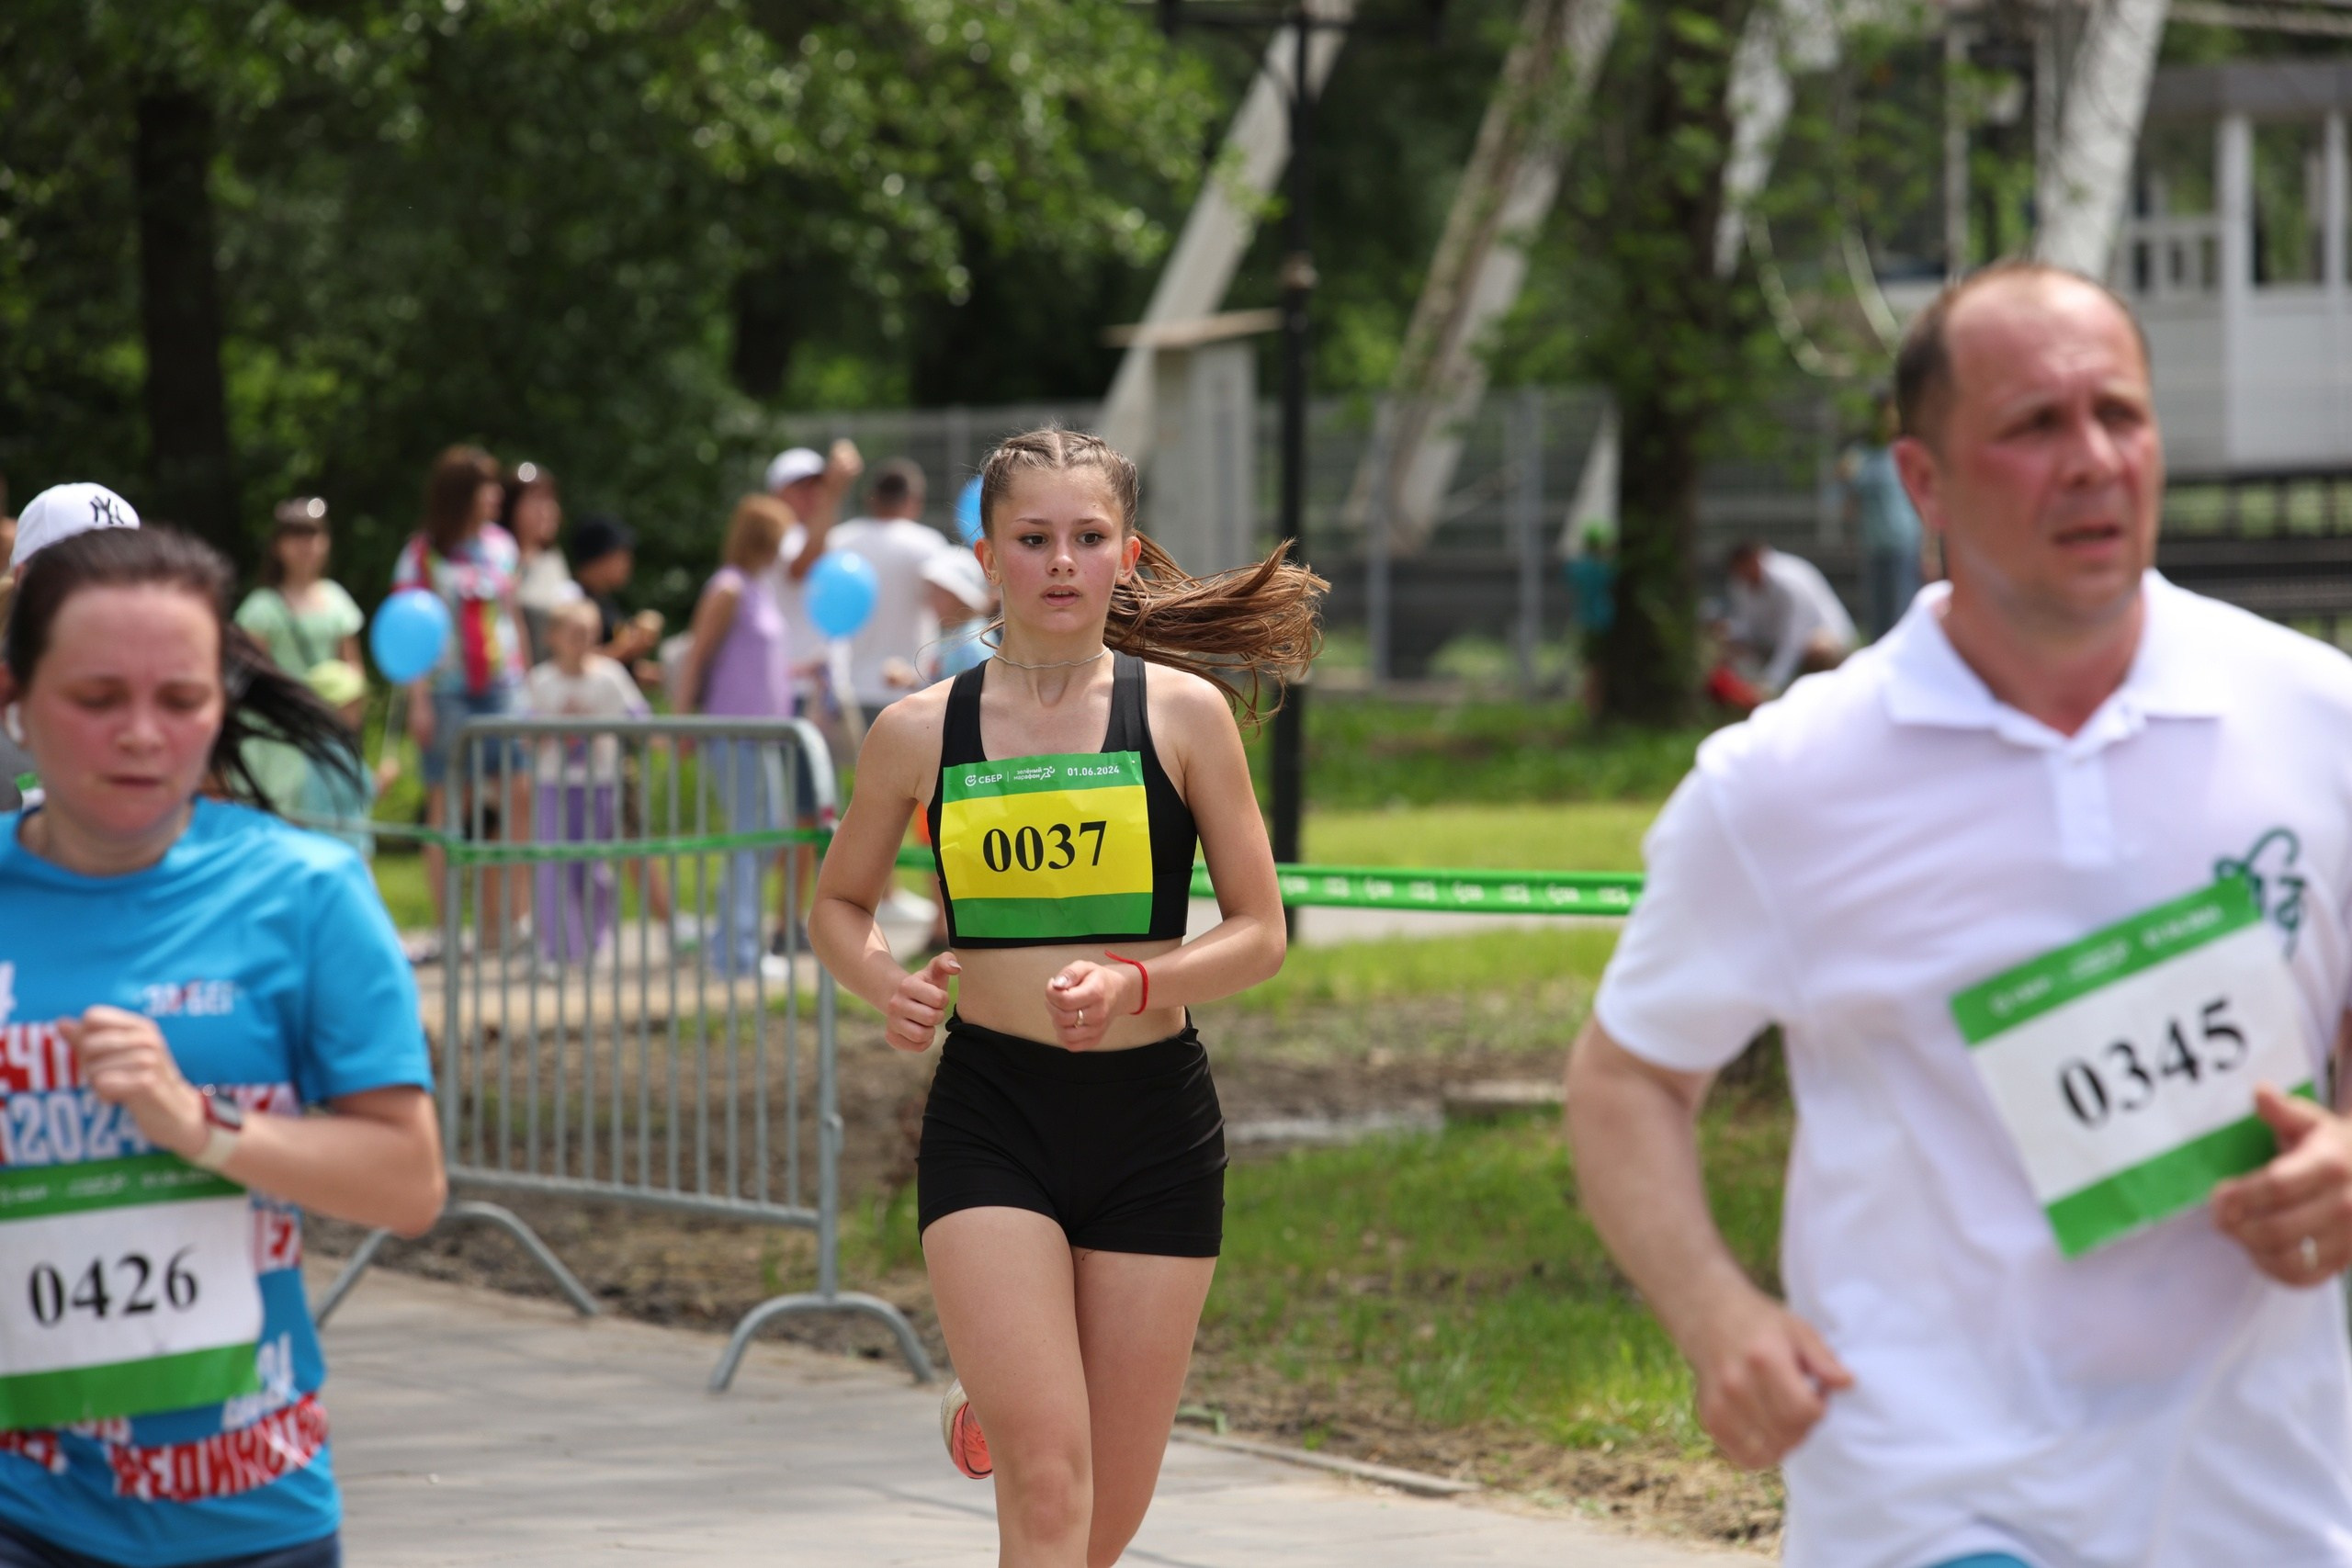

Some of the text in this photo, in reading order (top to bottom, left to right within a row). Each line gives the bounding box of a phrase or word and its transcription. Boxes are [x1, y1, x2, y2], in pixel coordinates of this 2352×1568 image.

[1016, 766, 1043, 774] зелёный
[1067, 765, 1120, 777] 01.06.2024
[978, 773, 1003, 784] СБЕР
[1013, 772, 1040, 781] марафон
[982, 820, 1107, 873] 0037
[2057, 995, 2250, 1129] 0345
[28, 1245, 199, 1328] 0426
